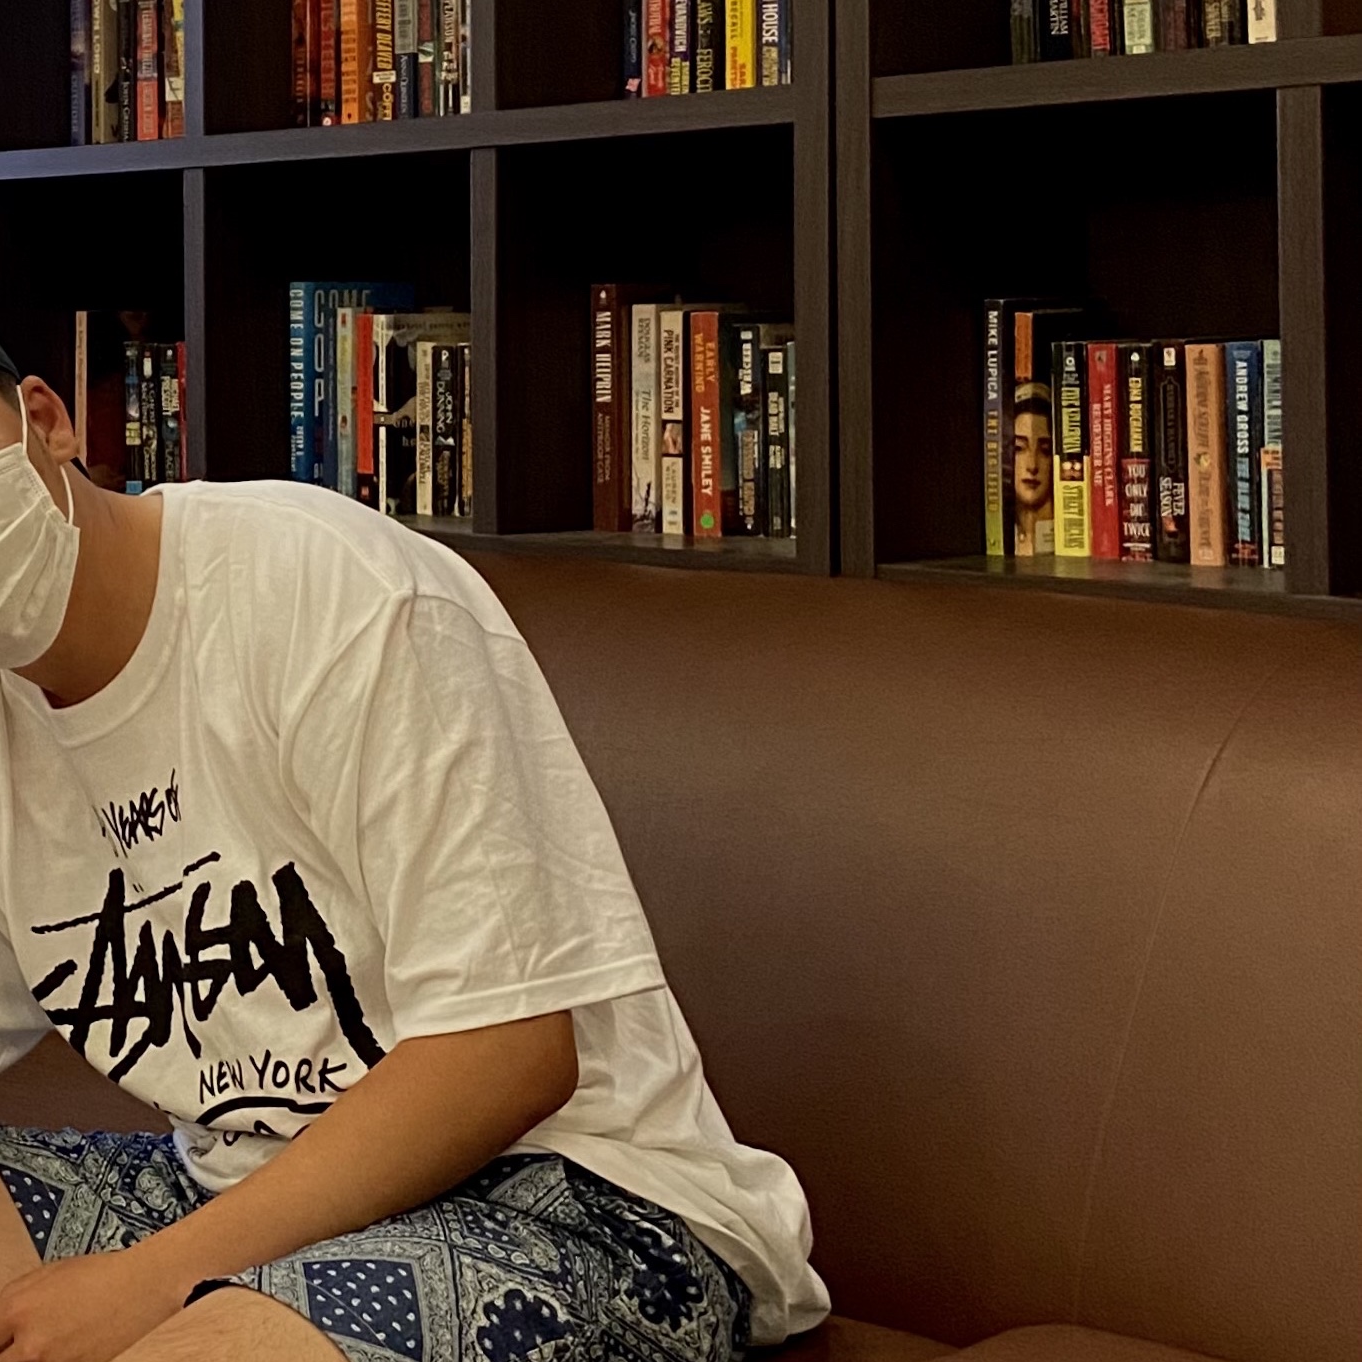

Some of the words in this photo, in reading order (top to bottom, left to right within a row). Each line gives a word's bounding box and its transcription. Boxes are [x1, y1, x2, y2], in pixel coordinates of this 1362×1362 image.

[762, 4, 779, 44] HOUSE
[696, 49, 713, 93] FEROCIT
[122, 107, 130, 140] GRISHA
[289, 289, 304, 330] COME
[595, 311, 612, 348] MARK
[987, 310, 999, 345] MIKE
[289, 337, 304, 357] ON
[663, 329, 674, 354] PINK
[595, 353, 612, 403] HELPRIN
[693, 332, 705, 394] WARNING
[705, 342, 716, 383] EARLY
[987, 349, 999, 400] LUPICA
[290, 362, 305, 419] PEOPLE
[641, 389, 652, 412] The
[663, 356, 674, 414] CARNATION
[1102, 383, 1112, 416] MARY
[1129, 377, 1142, 402] EDNA
[1235, 361, 1249, 412] ANDREW
[436, 380, 445, 433] DUNNING
[444, 391, 453, 424] JOHN
[700, 406, 711, 442] JANE
[641, 414, 652, 461] Horizon
[1092, 402, 1102, 467] REMEMBER
[1103, 418, 1114, 466] HIGGINS
[1236, 414, 1250, 454] GROSS
[700, 445, 713, 496] SMILEY
[1093, 469, 1103, 488] ME
[1104, 467, 1115, 507] CLARK
[1125, 483, 1148, 498] ONLY
[1127, 464, 1146, 479] YOU
[1159, 476, 1172, 518] SEASON
[1172, 482, 1185, 516] FEVER
[1122, 522, 1151, 537] TWICE
[199, 1057, 245, 1104] NEW
[249, 1048, 348, 1094] YORK
